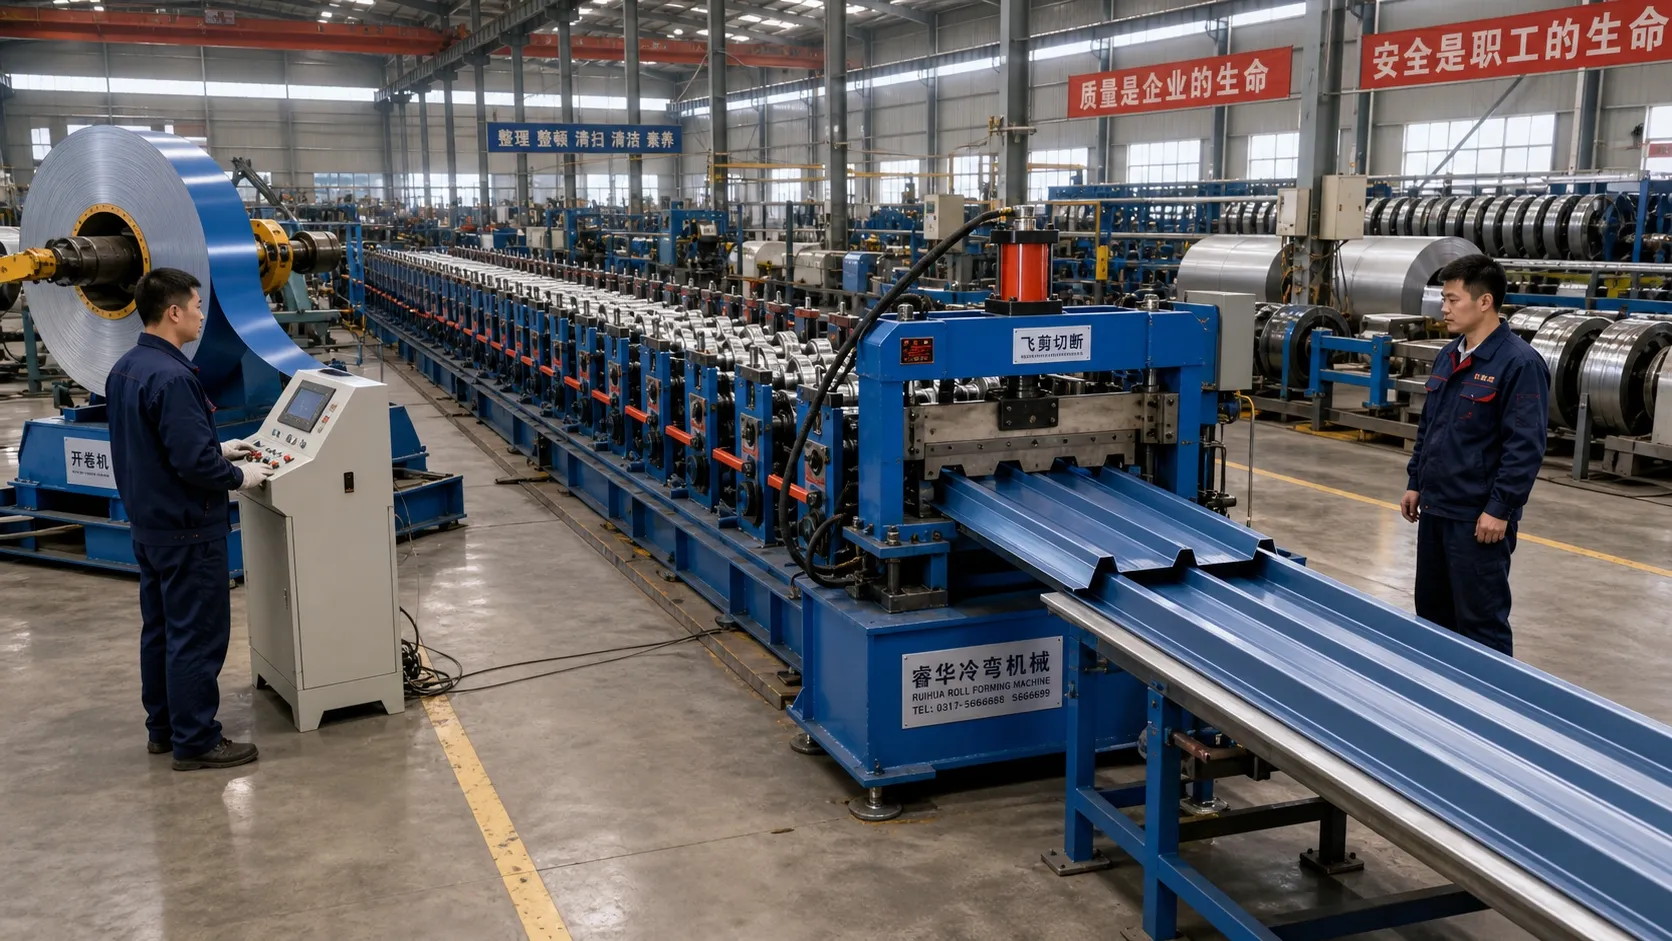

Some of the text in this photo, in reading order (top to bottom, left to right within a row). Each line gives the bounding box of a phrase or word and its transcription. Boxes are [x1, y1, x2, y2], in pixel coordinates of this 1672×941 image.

[1372, 5, 1670, 81] 安全是职工的生命
[1080, 58, 1269, 111] 质量是企业的生命
[498, 129, 674, 148] 整理 整顿 清扫 清洁 素养
[1021, 333, 1084, 352] 飞剪切断
[71, 451, 109, 470] 开卷机
[912, 650, 1050, 689] 睿华冷弯机械
[912, 676, 1051, 702] RUIHUA ROLL FORMING MACHINE
[912, 705, 933, 715] TEL:
